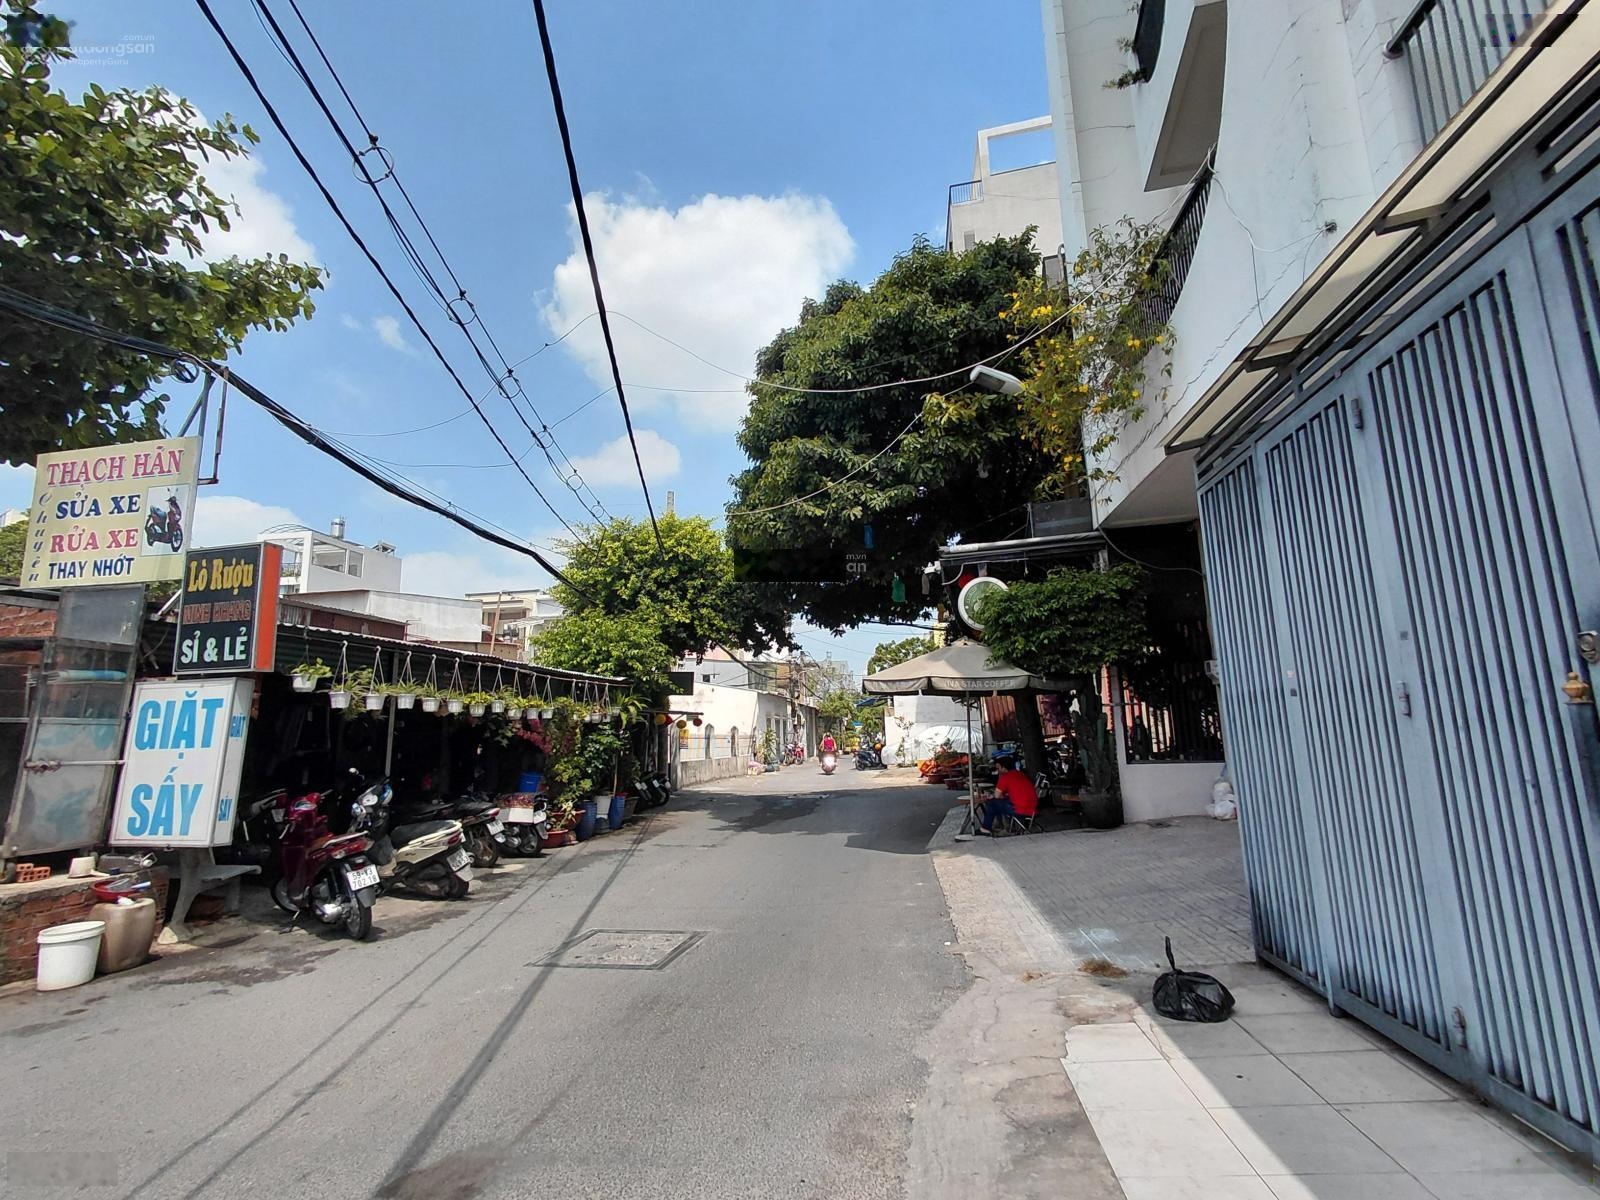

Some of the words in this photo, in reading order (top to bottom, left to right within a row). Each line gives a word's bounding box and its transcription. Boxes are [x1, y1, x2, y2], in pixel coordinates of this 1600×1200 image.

[48, 456, 126, 490] THẠCH
[56, 491, 102, 520] SỬA
[109, 494, 141, 515] XE
[50, 525, 99, 553] RỬA
[106, 528, 139, 549] XE
[49, 560, 88, 580] THAY
[92, 554, 135, 577] NHỚT
[210, 557, 254, 596] Rượu
[180, 630, 201, 664] SỈ
[203, 637, 218, 662] &
[223, 626, 248, 661] LẺ
[134, 690, 225, 760] GIẶT
[127, 766, 204, 837] SẤY
